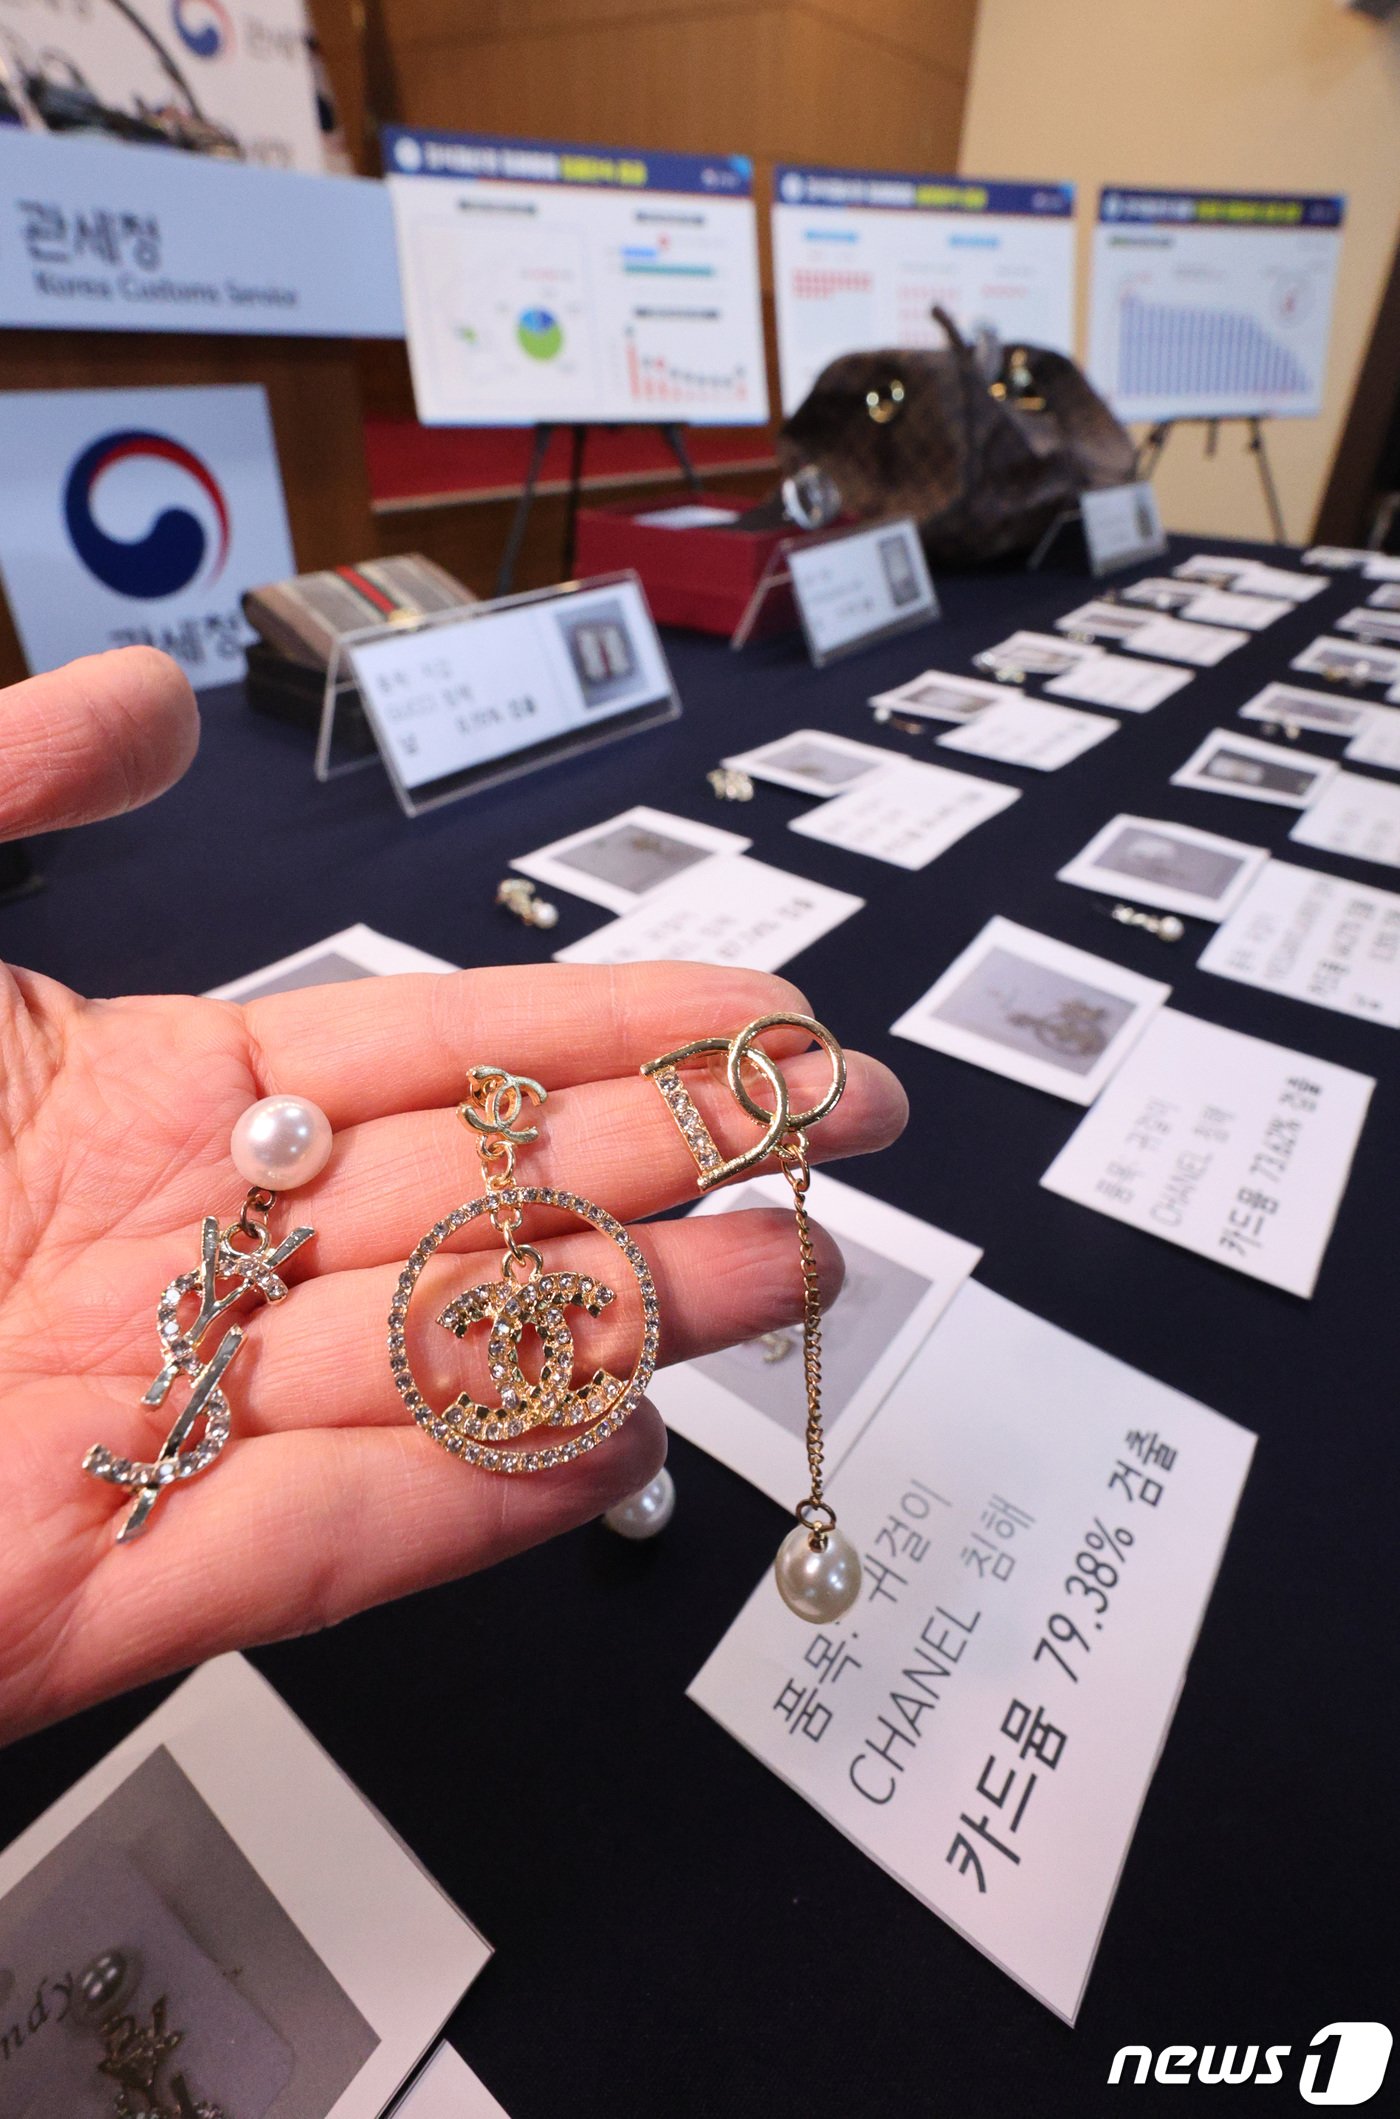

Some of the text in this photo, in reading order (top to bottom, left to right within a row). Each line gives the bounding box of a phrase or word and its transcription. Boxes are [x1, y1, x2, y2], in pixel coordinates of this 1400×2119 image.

[17, 199, 162, 272] 관세청
[34, 271, 112, 299] Korea
[1150, 1152, 1213, 1226] CHANEL
[850, 1494, 1036, 1804] CHANEL 침해
[946, 1428, 1178, 1894] 카드뮴 79.38% 검출
